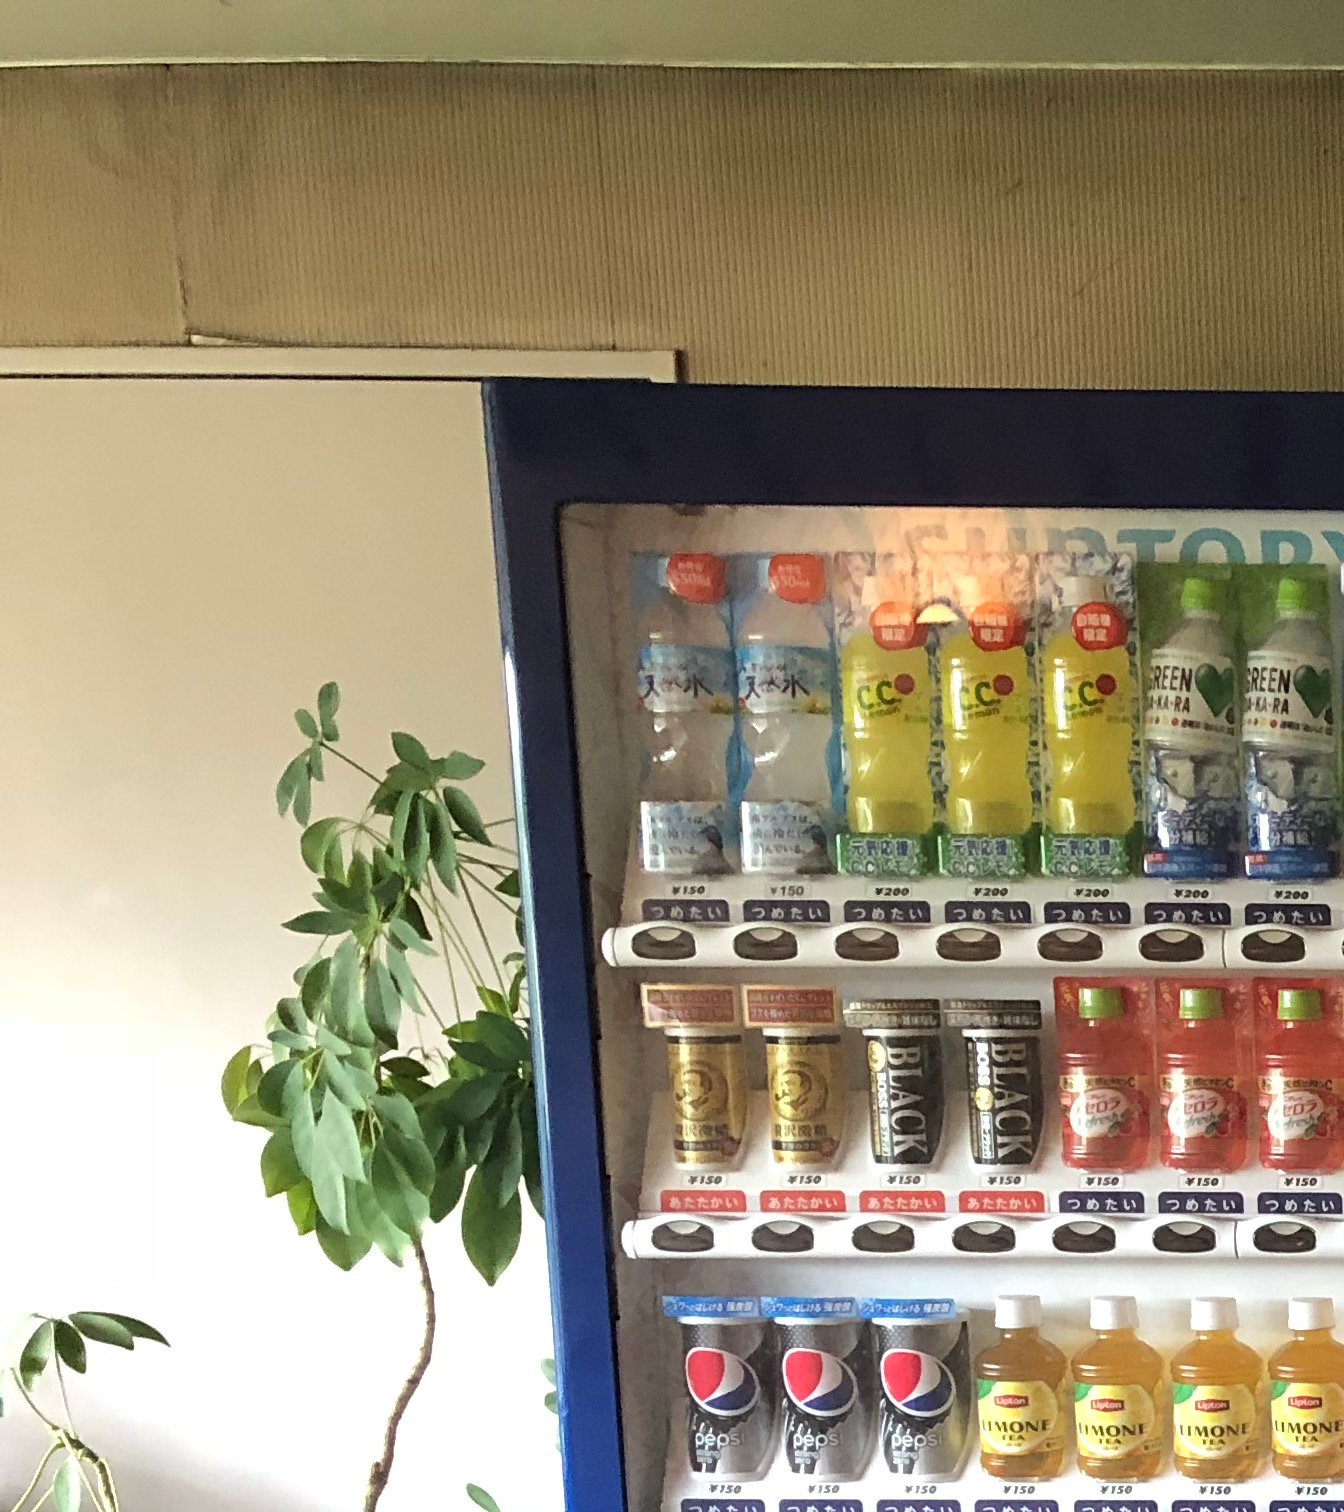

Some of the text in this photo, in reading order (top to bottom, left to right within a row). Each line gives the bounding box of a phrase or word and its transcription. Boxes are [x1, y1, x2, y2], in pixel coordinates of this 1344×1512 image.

[671, 885, 706, 896] ¥150
[875, 887, 910, 897] ¥200
[1074, 888, 1110, 898] ¥200
[1274, 890, 1309, 900] ¥200
[752, 907, 825, 920] つめたい
[953, 908, 1024, 921] つめたい
[1153, 910, 1224, 922] つめたい
[887, 1046, 928, 1157] BLACK
[991, 1042, 1034, 1157] BLACK
[688, 1175, 723, 1185] ¥150
[887, 1175, 921, 1185] ¥150
[1086, 1176, 1120, 1186] ¥150
[1284, 1177, 1318, 1187] ¥150
[767, 1196, 839, 1210] あたたかい
[967, 1197, 1038, 1210] あたたかい
[1166, 1198, 1237, 1212] つめたい
[996, 1395, 1027, 1408] Lipton
[1092, 1399, 1124, 1411] Lipton
[1197, 1400, 1229, 1412] Lipton
[1290, 1396, 1322, 1408] Lipton
[982, 1419, 1052, 1434] LIMONE
[1079, 1422, 1149, 1437] LIMONE
[1180, 1423, 1250, 1438] LIMONE
[1275, 1420, 1344, 1435] LIMONE
[695, 1431, 746, 1450] pepsi
[792, 1431, 844, 1451] pepsi
[891, 1431, 944, 1450] pepsi
[1001, 1433, 1026, 1442] TEA
[1099, 1437, 1122, 1446] TEA
[1202, 1437, 1225, 1446] TEA
[1294, 1434, 1318, 1443] TEA
[709, 1484, 742, 1495] ¥150
[905, 1485, 937, 1495] ¥150
[1100, 1485, 1133, 1495] ¥150
[1296, 1486, 1328, 1496] ¥150
